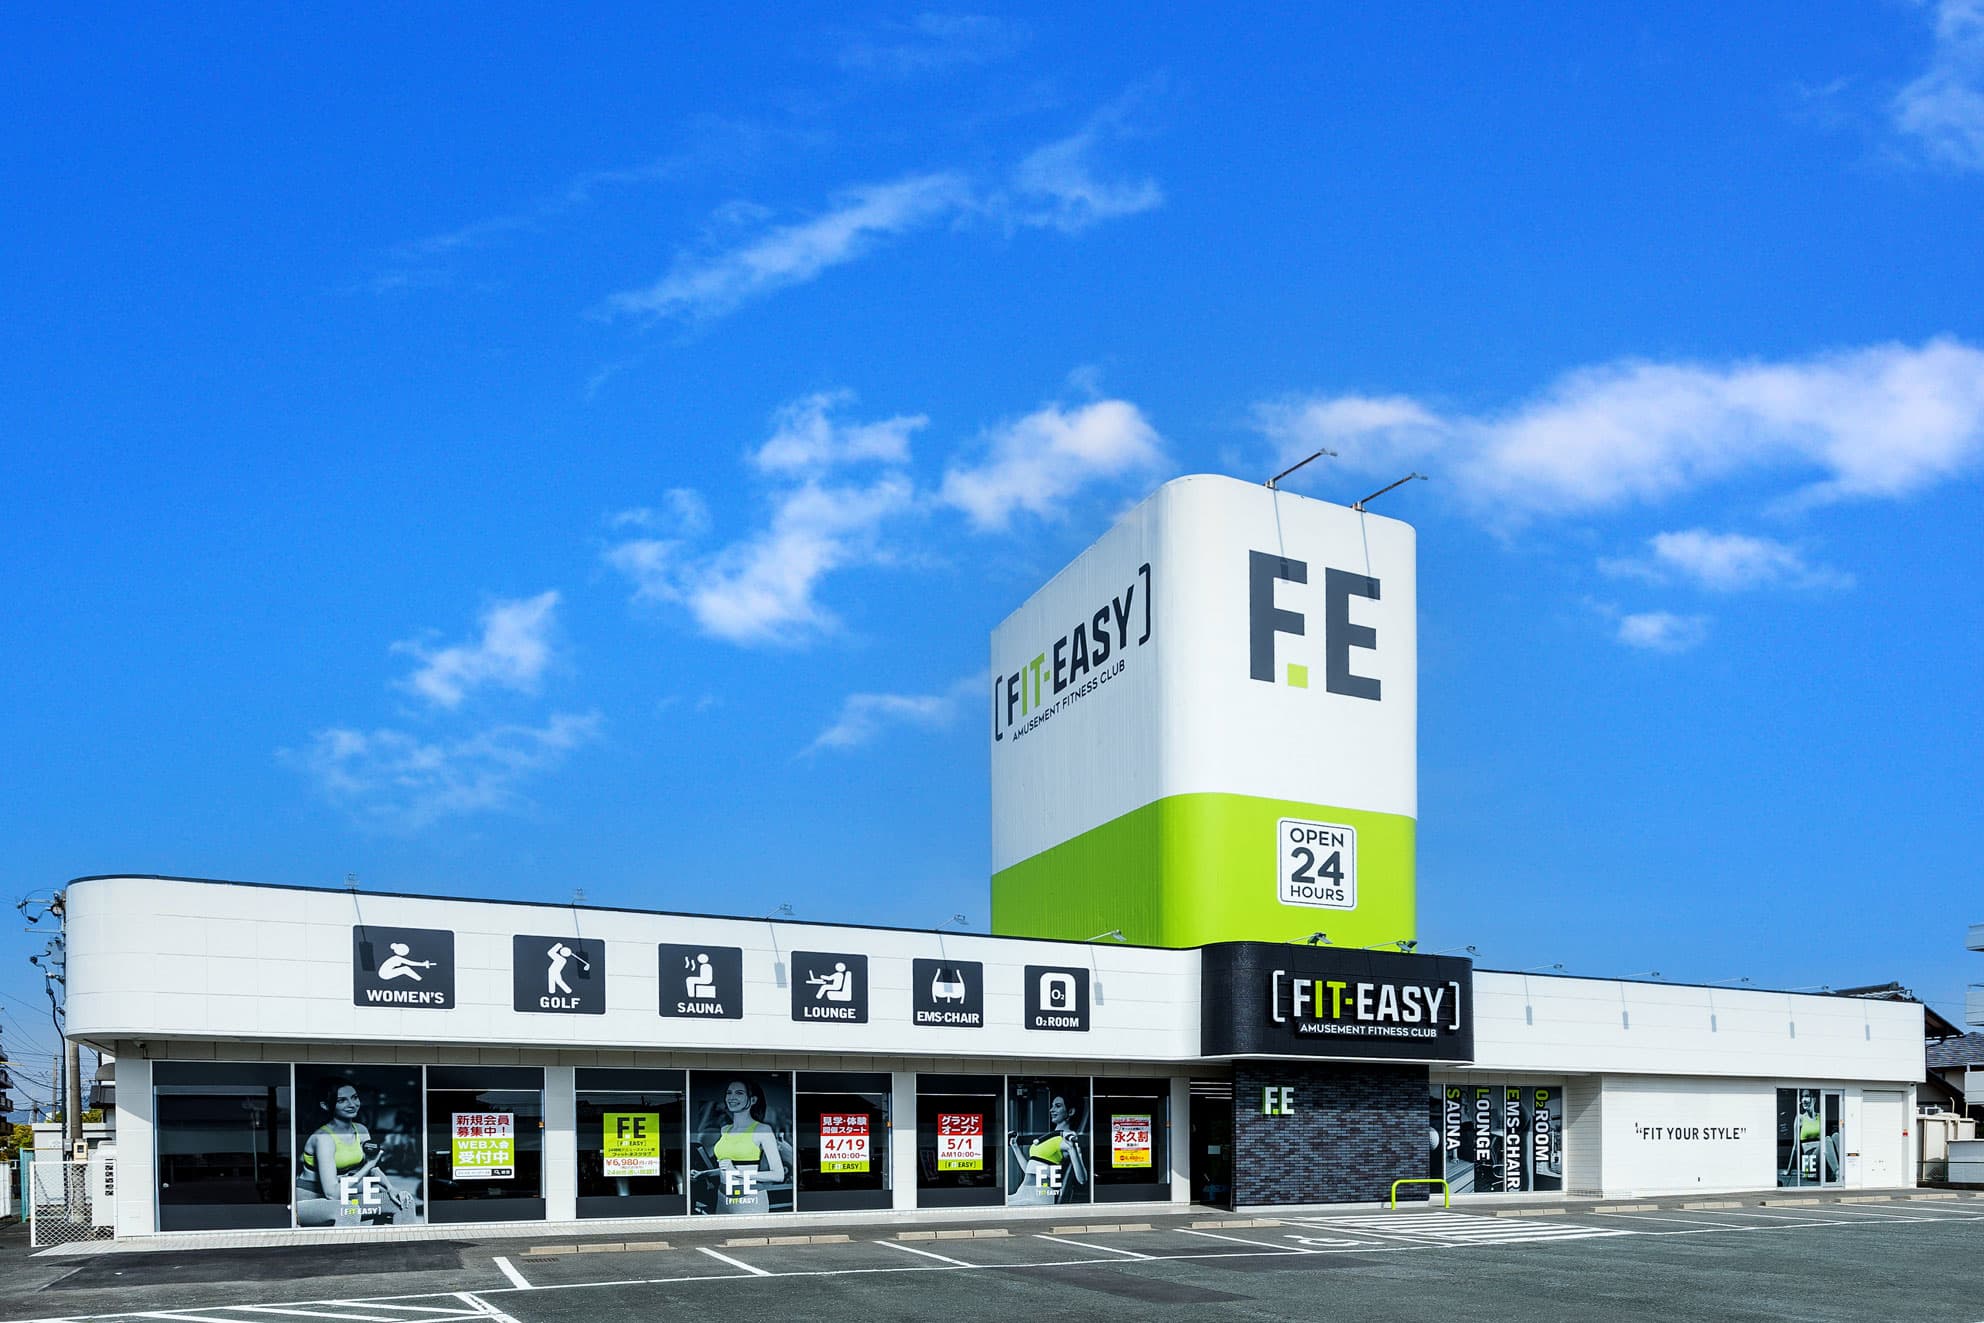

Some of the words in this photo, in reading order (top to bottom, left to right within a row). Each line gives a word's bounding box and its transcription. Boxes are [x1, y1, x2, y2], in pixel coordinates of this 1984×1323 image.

[1012, 702, 1061, 742] AMUSEMENT
[1062, 676, 1099, 711] FITNESS
[1100, 659, 1126, 685] CLUB
[1290, 827, 1344, 848] OPEN
[1291, 846, 1344, 887] 24
[1290, 884, 1344, 902] HOURS
[366, 988, 445, 1005] WOMEN'S
[539, 996, 581, 1009] GOLF
[677, 1001, 724, 1015] SAUNA
[804, 1006, 857, 1019] LOUNGE
[1300, 1023, 1366, 1035] AMUSEMENT
[1368, 1026, 1409, 1037] FITNESS
[1411, 1027, 1438, 1038] CLUB
[456, 1114, 510, 1126] 新規会員
[941, 1116, 979, 1126] グランド
[1446, 1088, 1461, 1150] SAUNA
[1476, 1088, 1491, 1161] LOUNGE
[941, 1125, 979, 1135] オープン
[1114, 1130, 1149, 1143] 永久割
[1667, 1127, 1700, 1141] YOUR
[457, 1140, 510, 1150] WEB入会
[825, 1138, 865, 1151] 4/19
[947, 1138, 972, 1150] 5/1
[1506, 1089, 1521, 1192] EMS-CHAIR
[458, 1150, 510, 1165] 受付中
